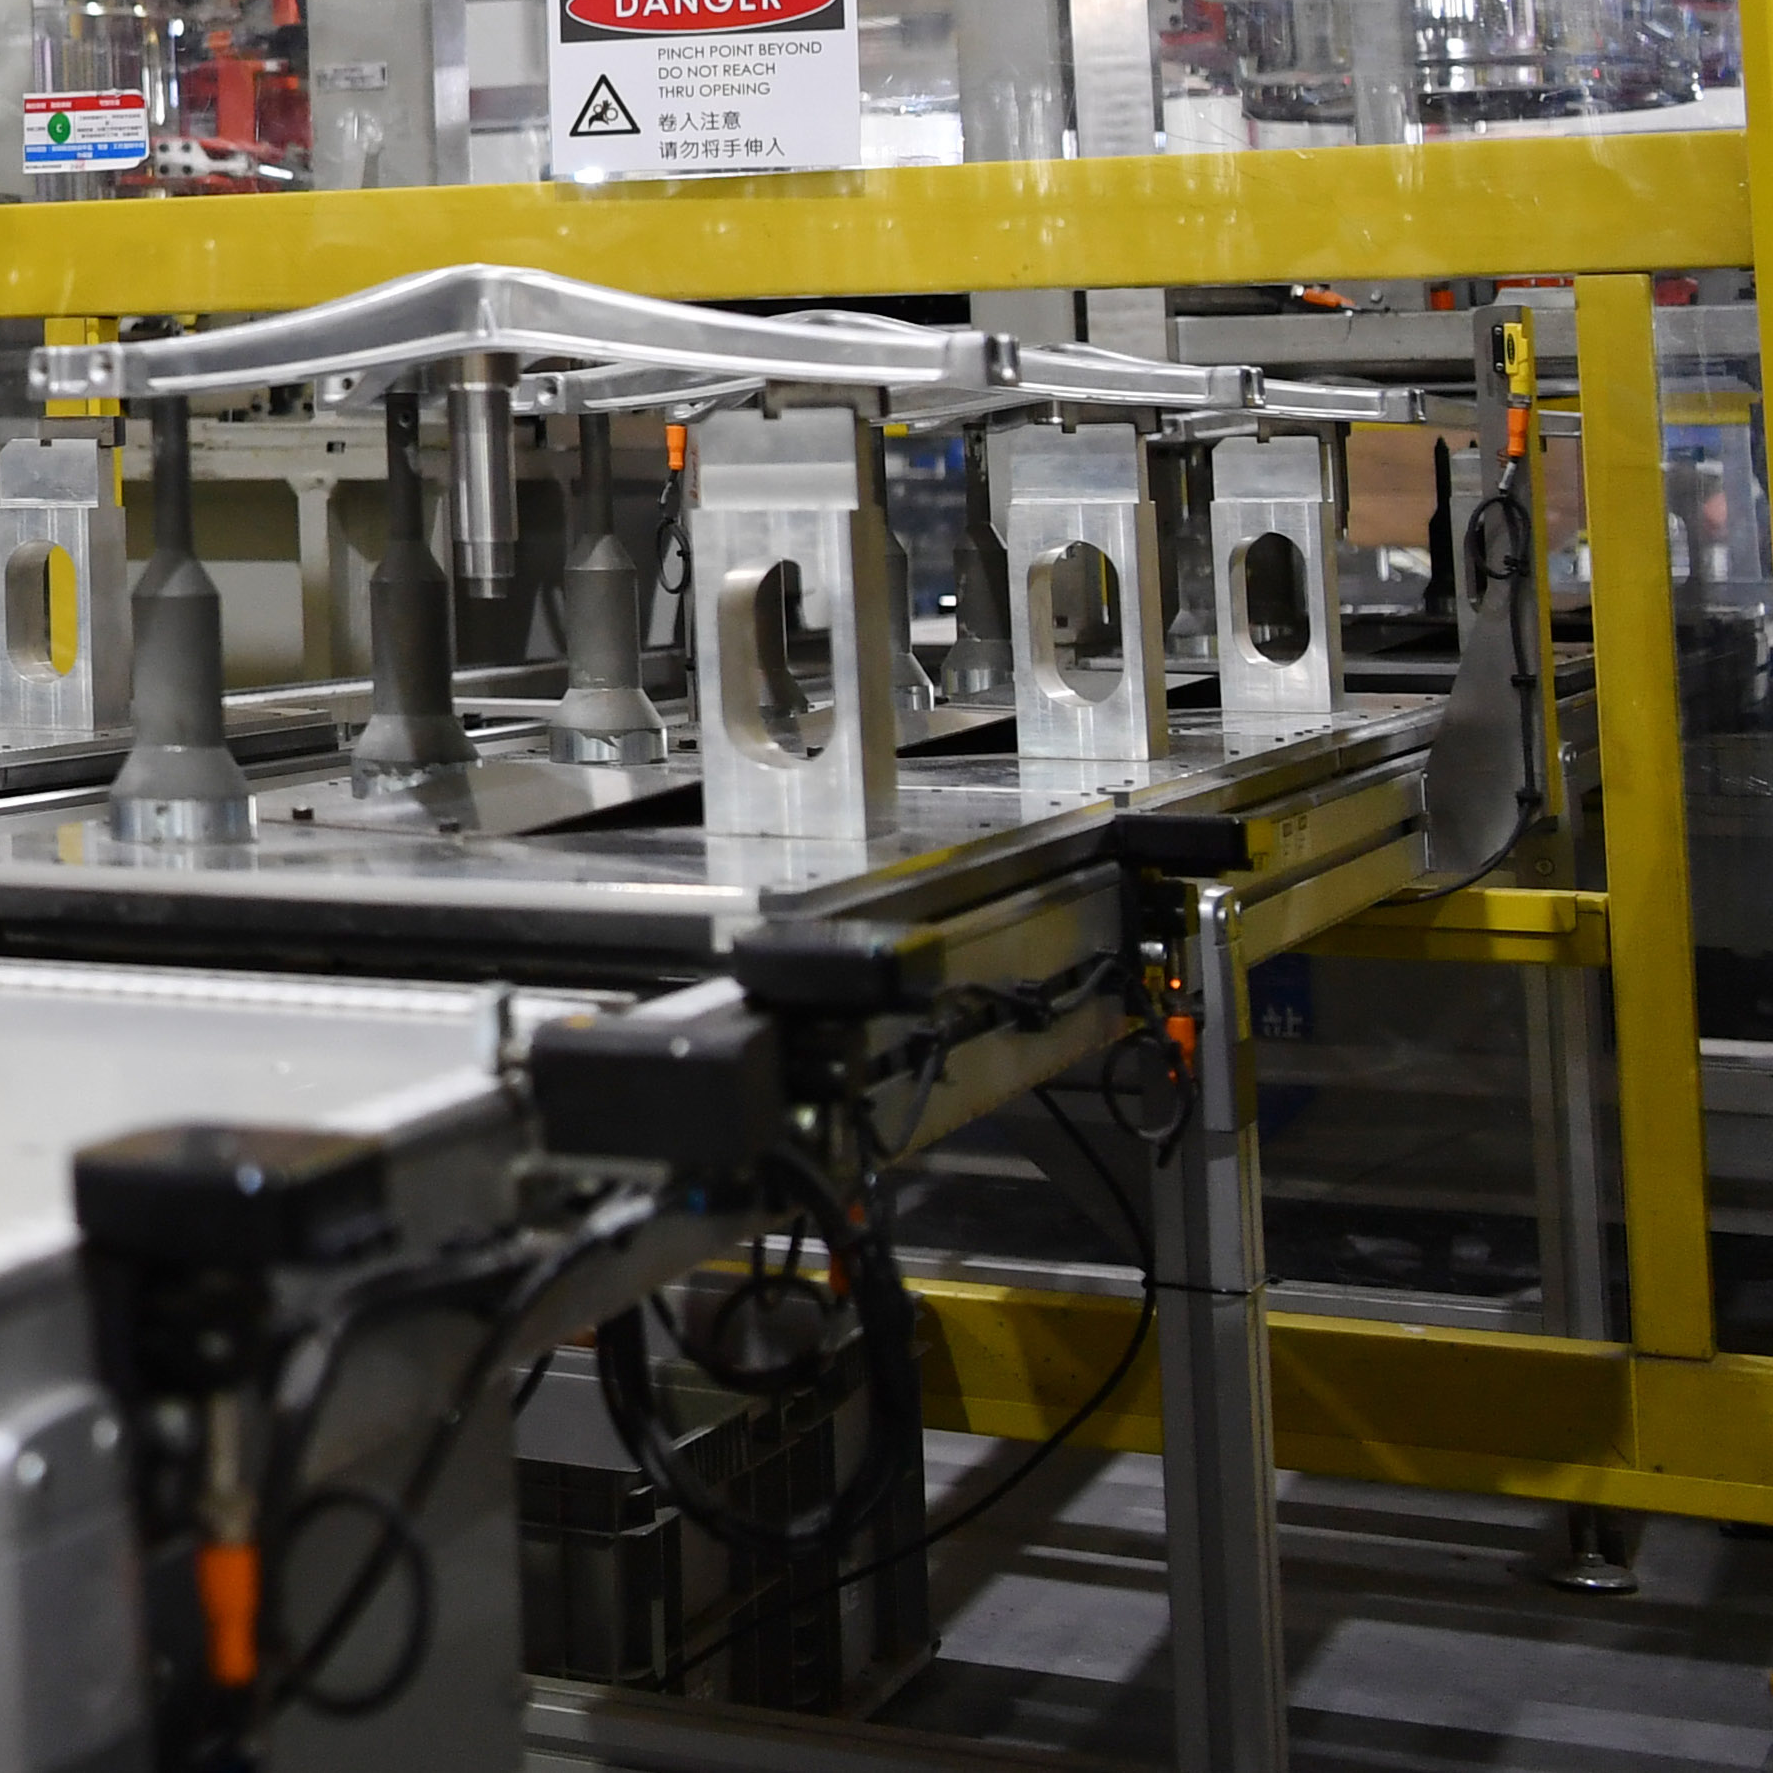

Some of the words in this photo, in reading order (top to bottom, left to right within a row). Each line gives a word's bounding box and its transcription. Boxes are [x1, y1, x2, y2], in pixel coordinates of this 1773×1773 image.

[657, 45, 705, 61] PINCH
[709, 44, 755, 59] POINT
[758, 41, 823, 57] BEYOND
[657, 65, 684, 80] DO
[688, 64, 719, 79] NOT
[722, 62, 777, 77] REACH
[658, 85, 695, 99] THRU
[698, 81, 772, 98] OPENING
[657, 110, 742, 133] 卷入注意
[658, 137, 786, 160] 请勿将手伸入
